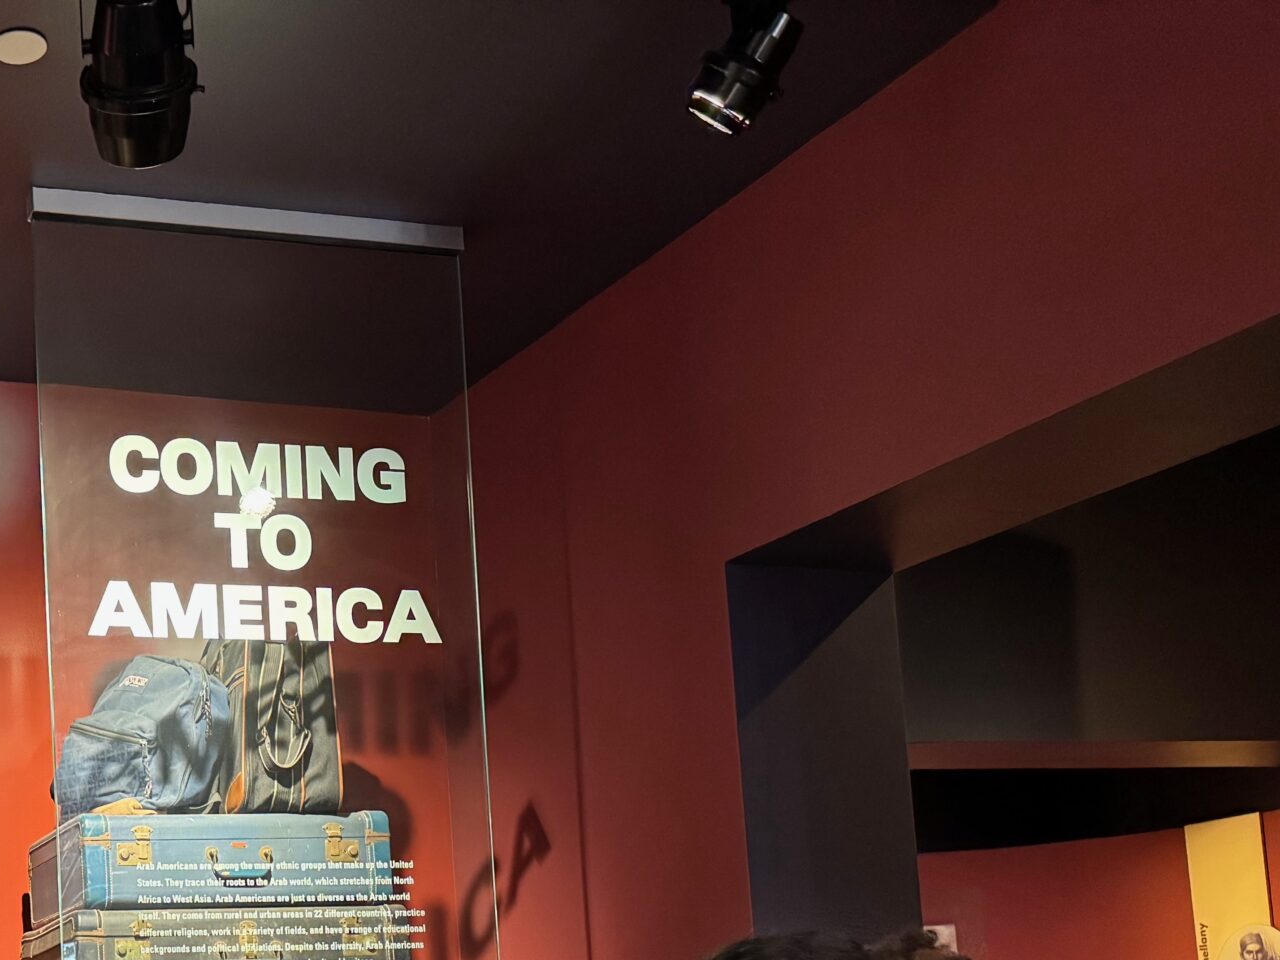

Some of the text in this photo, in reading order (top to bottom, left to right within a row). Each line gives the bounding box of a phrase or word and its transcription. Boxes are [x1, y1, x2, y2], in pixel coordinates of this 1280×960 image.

[109, 435, 406, 504] COMING
[214, 512, 312, 571] TO
[88, 580, 442, 644] AMERICA
[137, 876, 414, 888] States. They trace their roots to the Arab world, which stretches from North
[138, 895, 161, 904] Africa
[163, 895, 171, 903] to
[172, 895, 192, 903] West
[194, 895, 213, 903] Asia.
[215, 894, 233, 903] Arab
[235, 894, 275, 902] Americans
[292, 894, 305, 904] just
[318, 893, 344, 901] diverse
[356, 893, 368, 901] the
[370, 893, 387, 901] Arab
[389, 892, 410, 901] world
